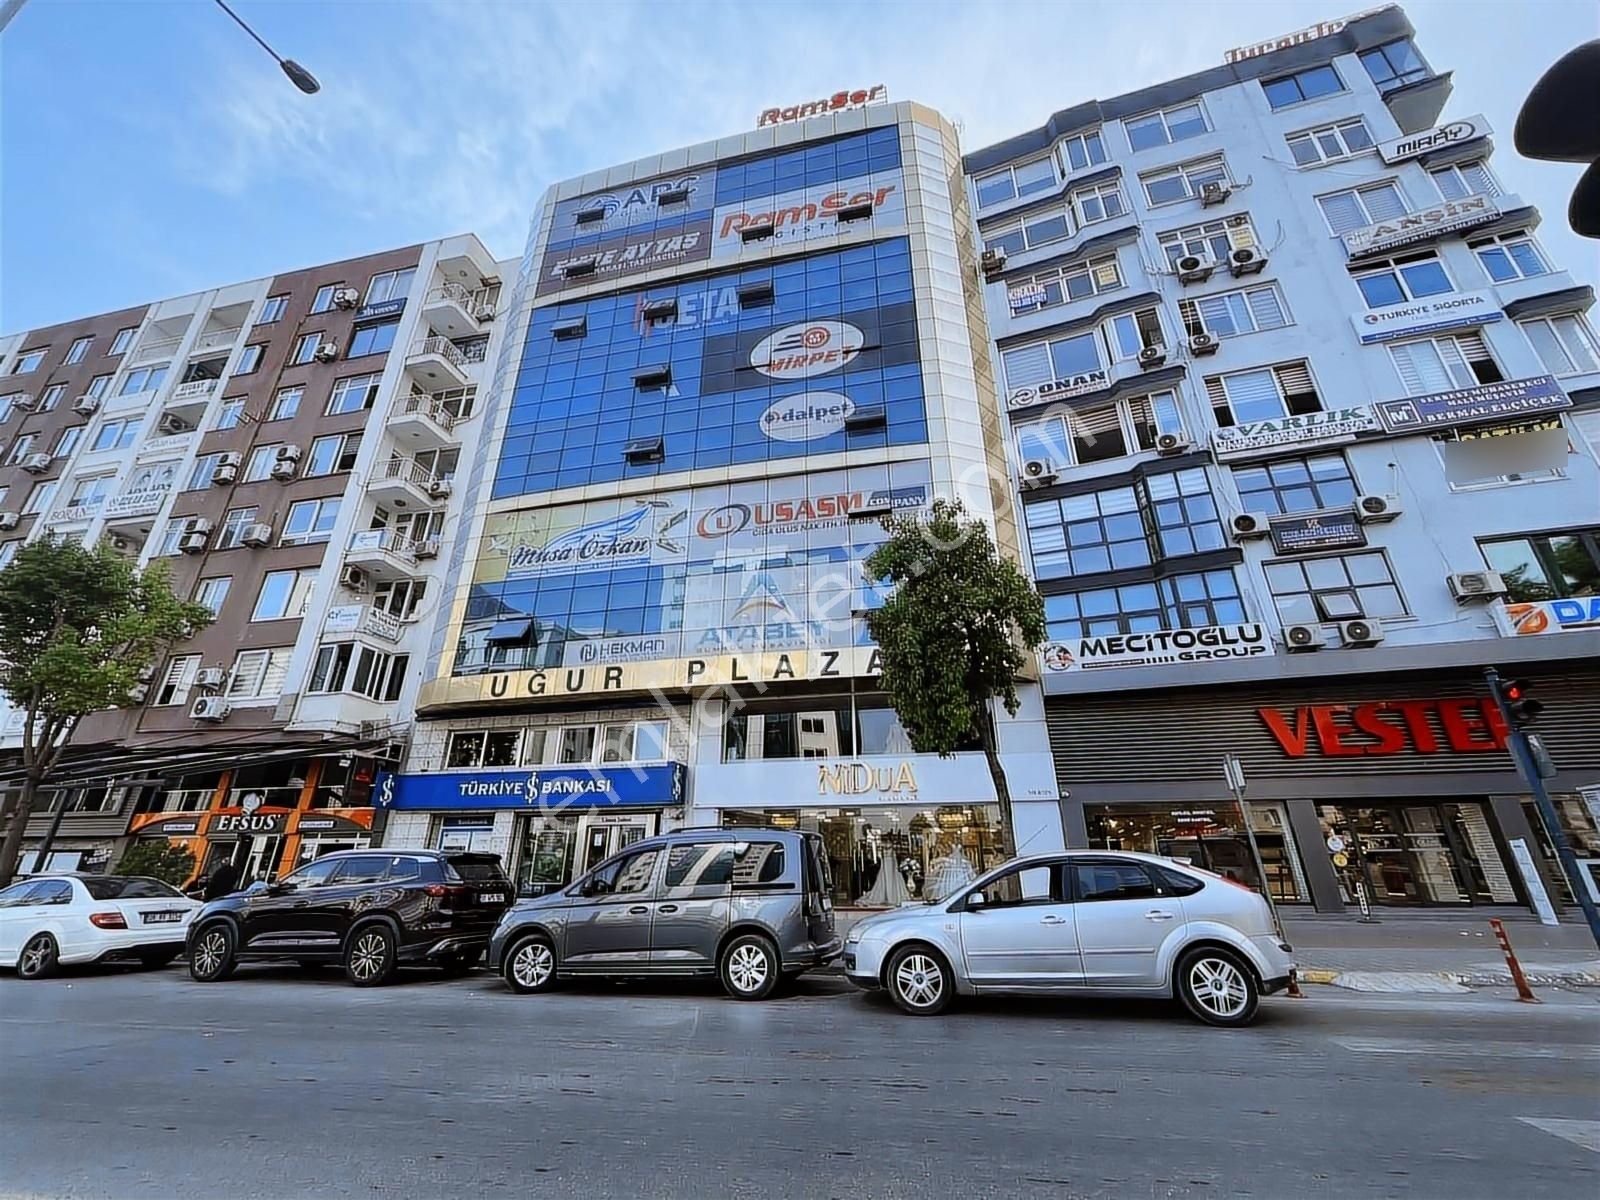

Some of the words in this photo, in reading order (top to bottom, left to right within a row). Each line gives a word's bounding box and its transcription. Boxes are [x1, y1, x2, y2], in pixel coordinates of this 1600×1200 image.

[1237, 406, 1365, 437] VARLIK
[754, 492, 863, 525] USASM
[1179, 645, 1267, 662] GROUP
[490, 665, 623, 698] UĞUR
[687, 649, 884, 684] PLAZA
[459, 778, 523, 797] TÜRKİYE
[541, 778, 611, 795] BANKASI
